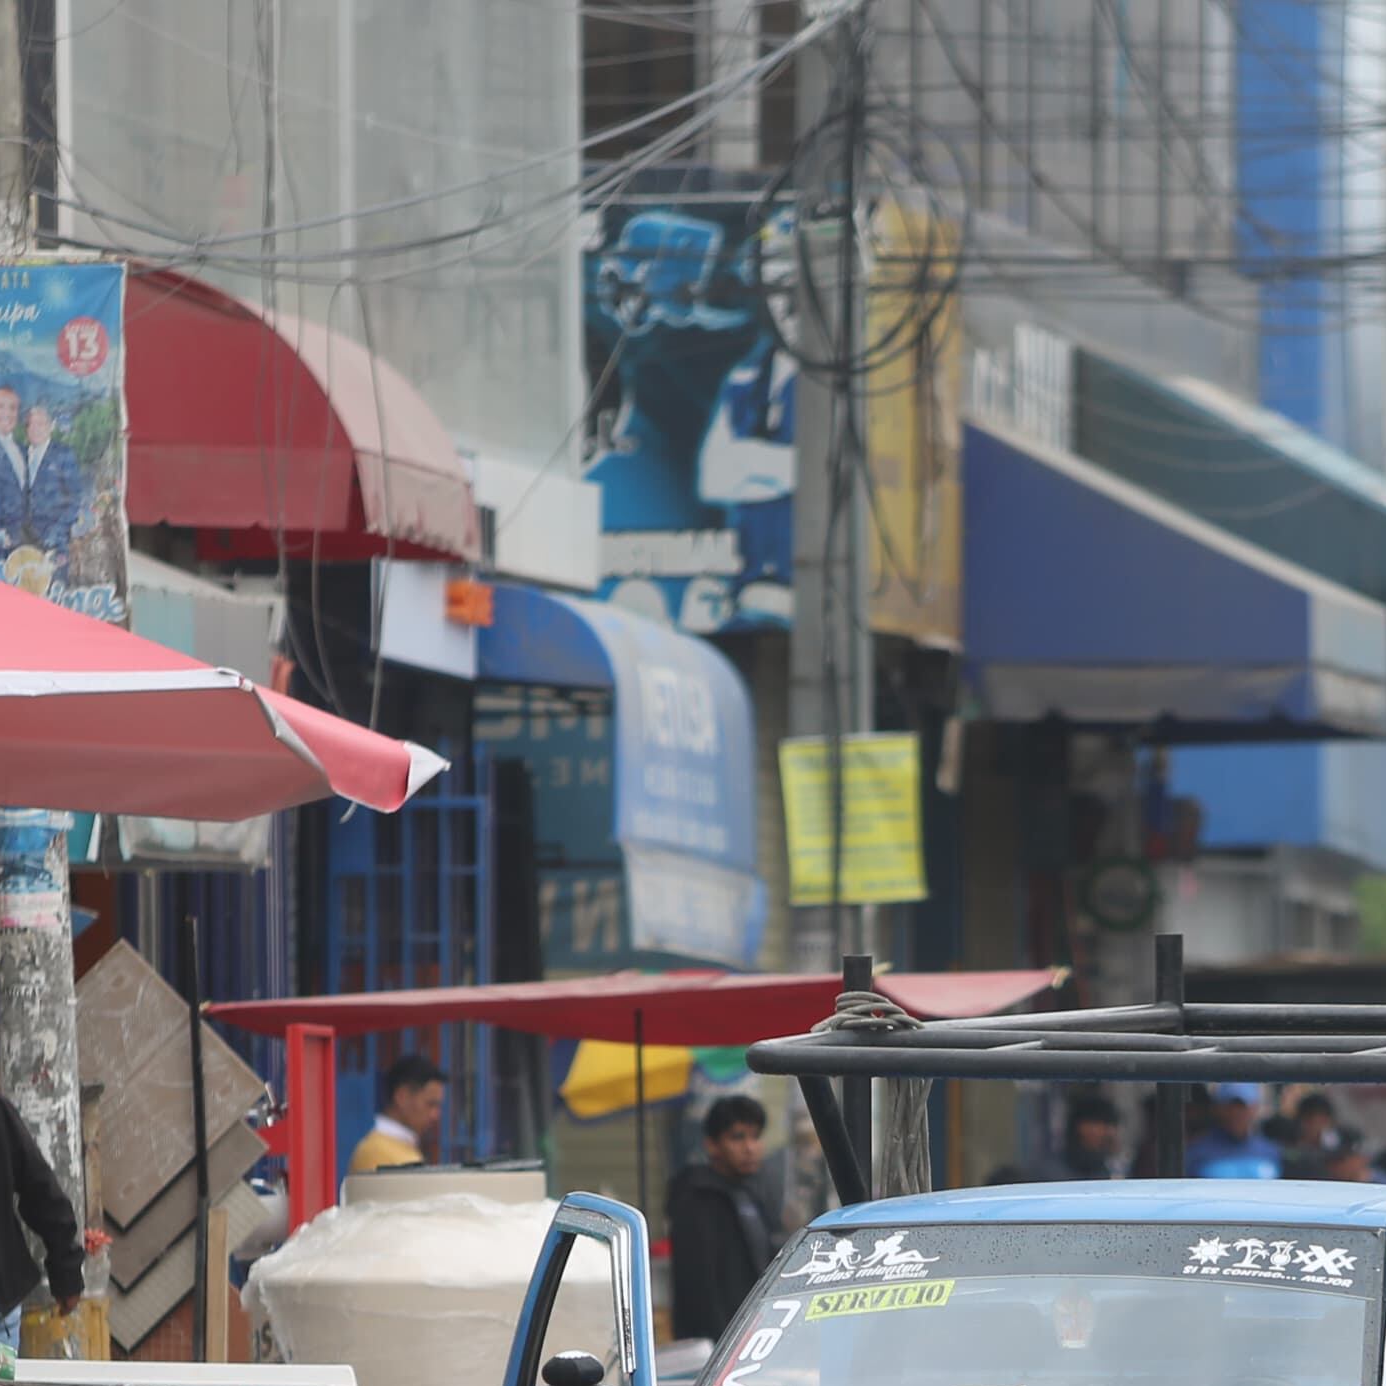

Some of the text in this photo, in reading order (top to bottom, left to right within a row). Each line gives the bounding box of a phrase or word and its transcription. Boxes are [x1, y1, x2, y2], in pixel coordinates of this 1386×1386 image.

[64, 329, 101, 361] 13
[1182, 1265, 1354, 1288] SI ES CONTIGO... MEJOR
[813, 1284, 946, 1315] SERVICIO
